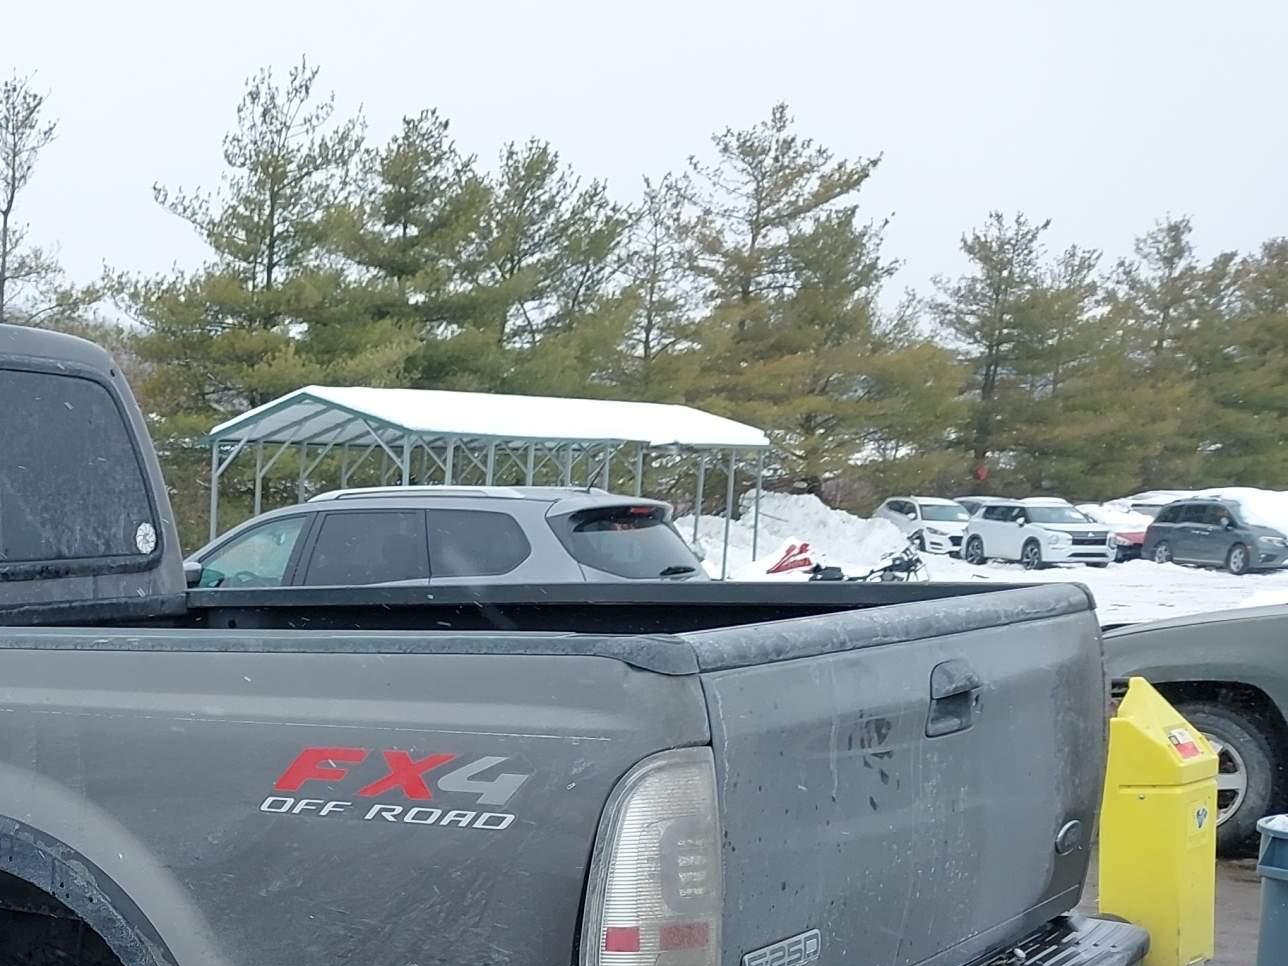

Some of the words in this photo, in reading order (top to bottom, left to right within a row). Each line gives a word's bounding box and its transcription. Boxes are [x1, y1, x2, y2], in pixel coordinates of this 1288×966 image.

[272, 747, 530, 806] FX4
[260, 796, 353, 816] OFF
[364, 804, 516, 830] ROAD
